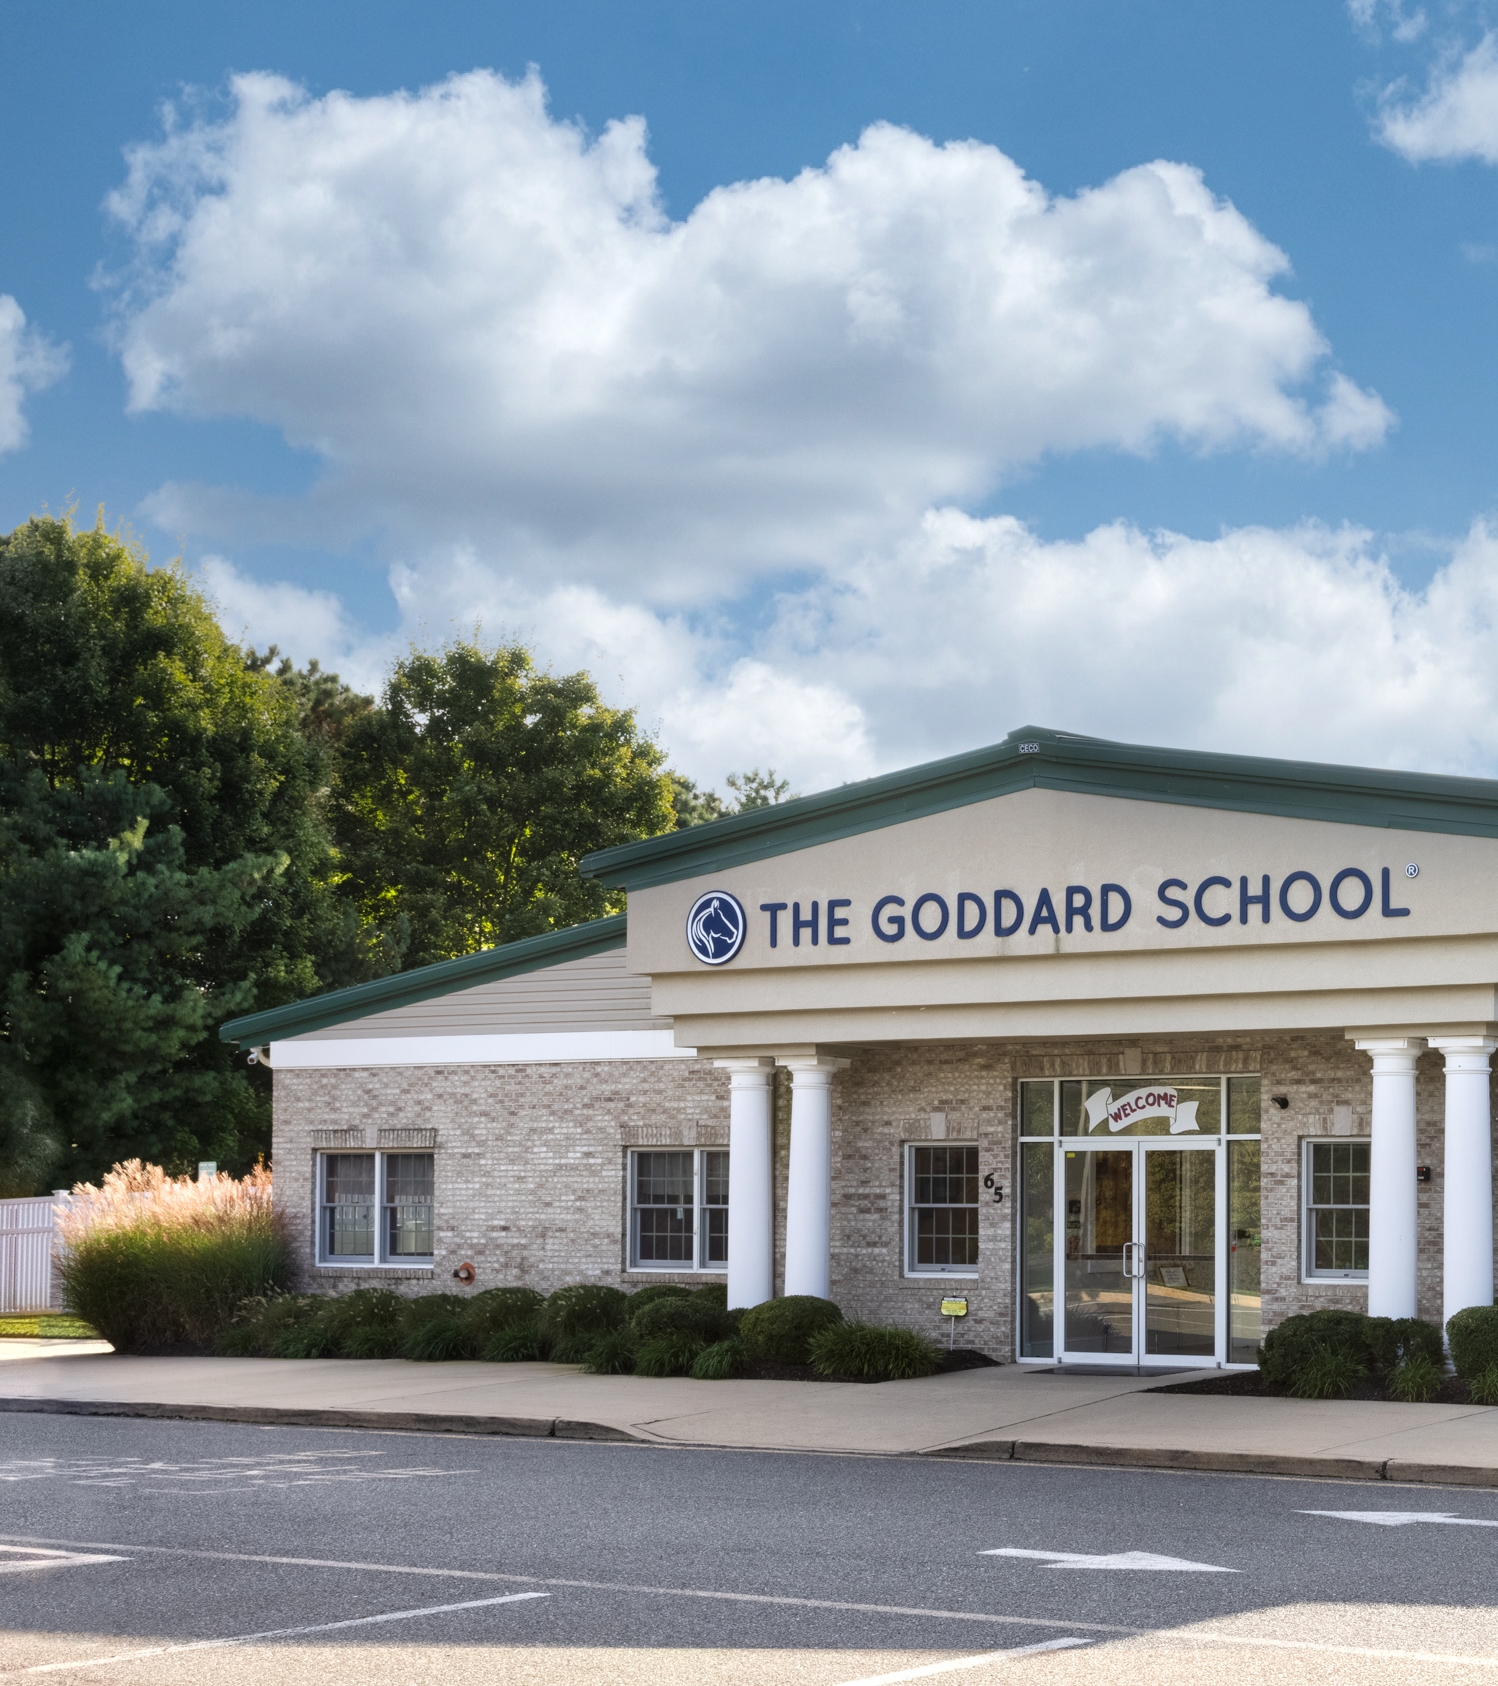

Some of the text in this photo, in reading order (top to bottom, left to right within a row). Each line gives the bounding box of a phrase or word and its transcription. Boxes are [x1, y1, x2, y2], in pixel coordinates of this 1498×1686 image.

[1019, 744, 1039, 752] CECO
[760, 899, 852, 948] THE
[871, 884, 1132, 943] GODDARD
[1156, 867, 1411, 929] SCHOOL
[1109, 1092, 1177, 1123] WELCOME
